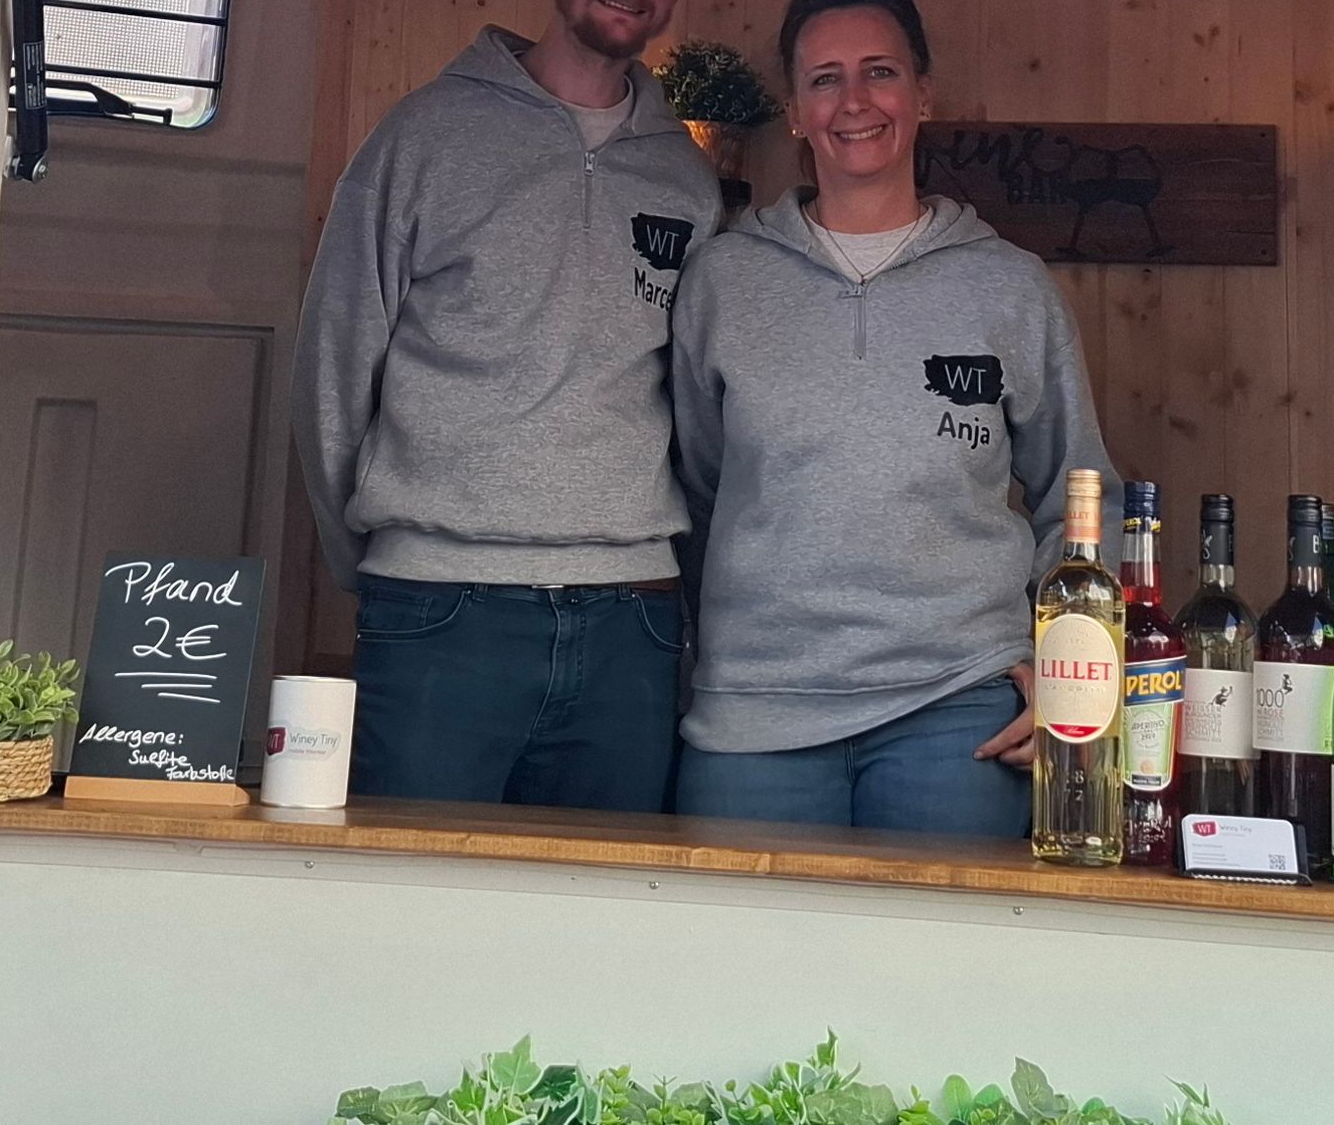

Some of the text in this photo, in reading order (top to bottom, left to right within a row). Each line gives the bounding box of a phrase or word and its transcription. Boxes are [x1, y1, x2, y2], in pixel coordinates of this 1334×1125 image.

[646, 224, 680, 261] WT
[634, 267, 673, 312] Marce
[944, 364, 986, 394] WT
[937, 411, 990, 450] Anja
[104, 561, 243, 607] Pfand
[132, 616, 227, 661] 2€
[1040, 658, 1113, 681] LILLET
[1126, 670, 1182, 697] PEROL
[78, 723, 185, 745] Allergene:
[289, 732, 318, 747] Winey
[321, 733, 338, 747] Tiny
[128, 749, 191, 768] Sulfite
